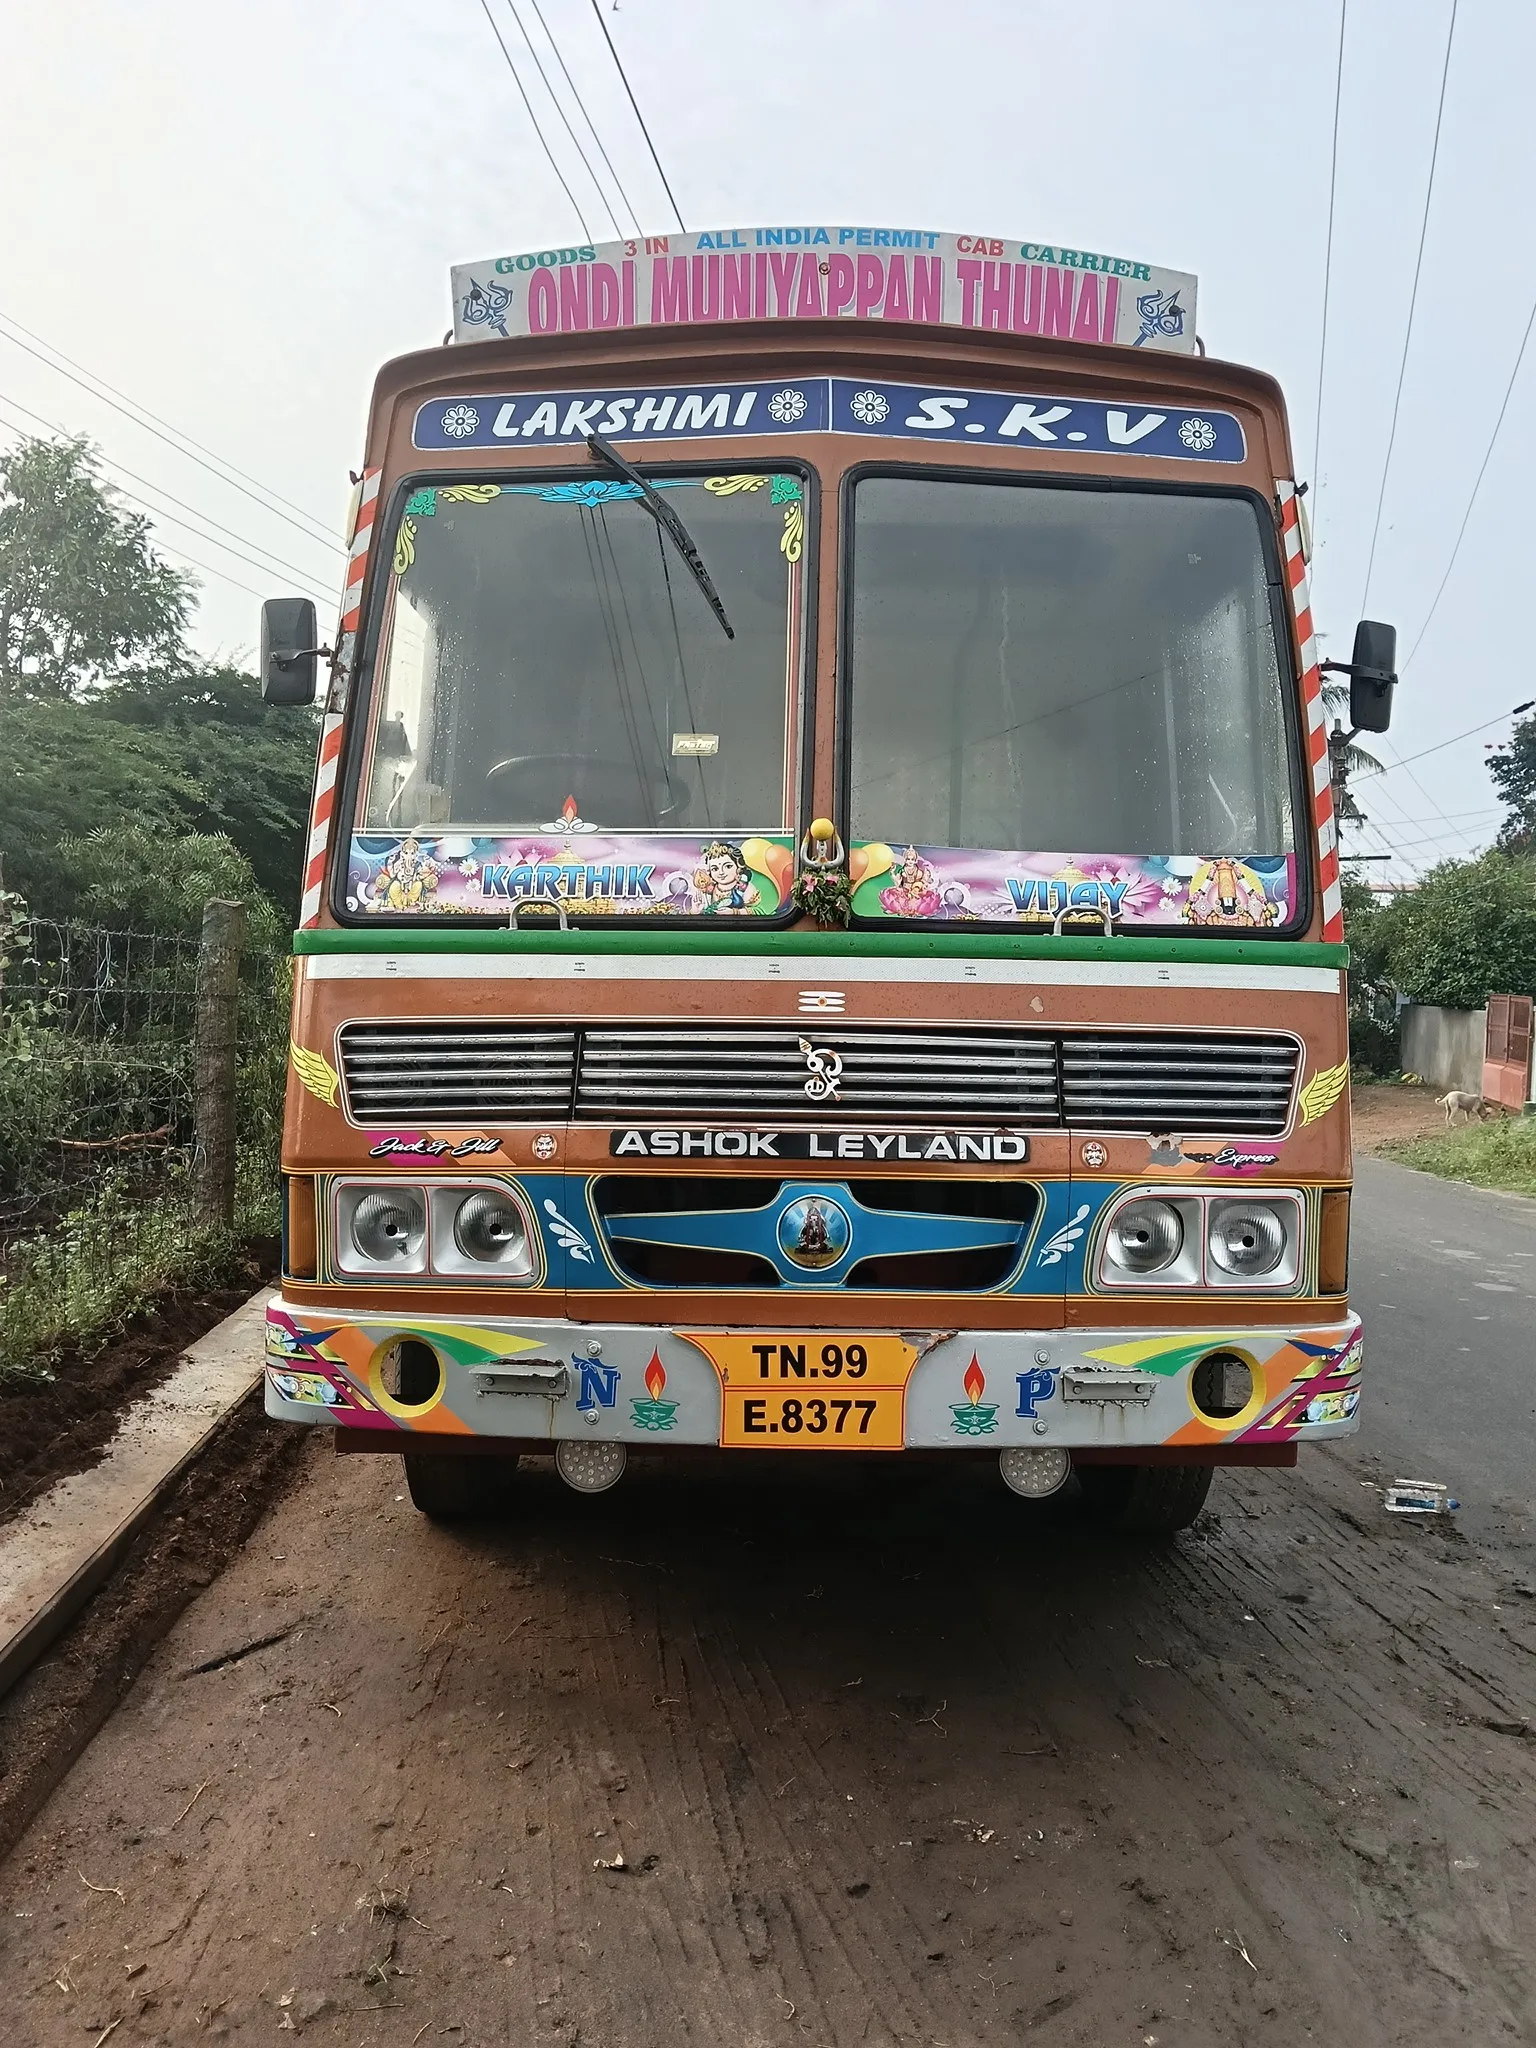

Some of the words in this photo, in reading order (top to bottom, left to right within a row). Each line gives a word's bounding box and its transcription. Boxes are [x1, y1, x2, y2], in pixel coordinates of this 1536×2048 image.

[495, 245, 597, 275] GOODS
[624, 240, 638, 257] 3
[645, 237, 670, 255] IN
[697, 231, 748, 250] ALL
[756, 227, 831, 246] INDIA
[838, 228, 941, 250] PERMIT
[956, 235, 1005, 257] CAB
[1020, 243, 1152, 282] CARRIER
[528, 260, 638, 334] ONDI
[651, 252, 945, 324] MUNIYAPPAN
[956, 257, 1124, 345] THUNAI
[491, 391, 758, 438] LAKSHMI
[481, 862, 657, 902] KARTHIK
[1005, 876, 1130, 919] VIJAY
[368, 1136, 427, 1158] Jack
[450, 1137, 503, 1157] Jill
[615, 1130, 780, 1157] ASHOK
[809, 1133, 1027, 1161] LEYLAND
[1213, 1147, 1277, 1169] Express
[752, 1344, 869, 1379] TN.99
[742, 1399, 878, 1435] E.8377
